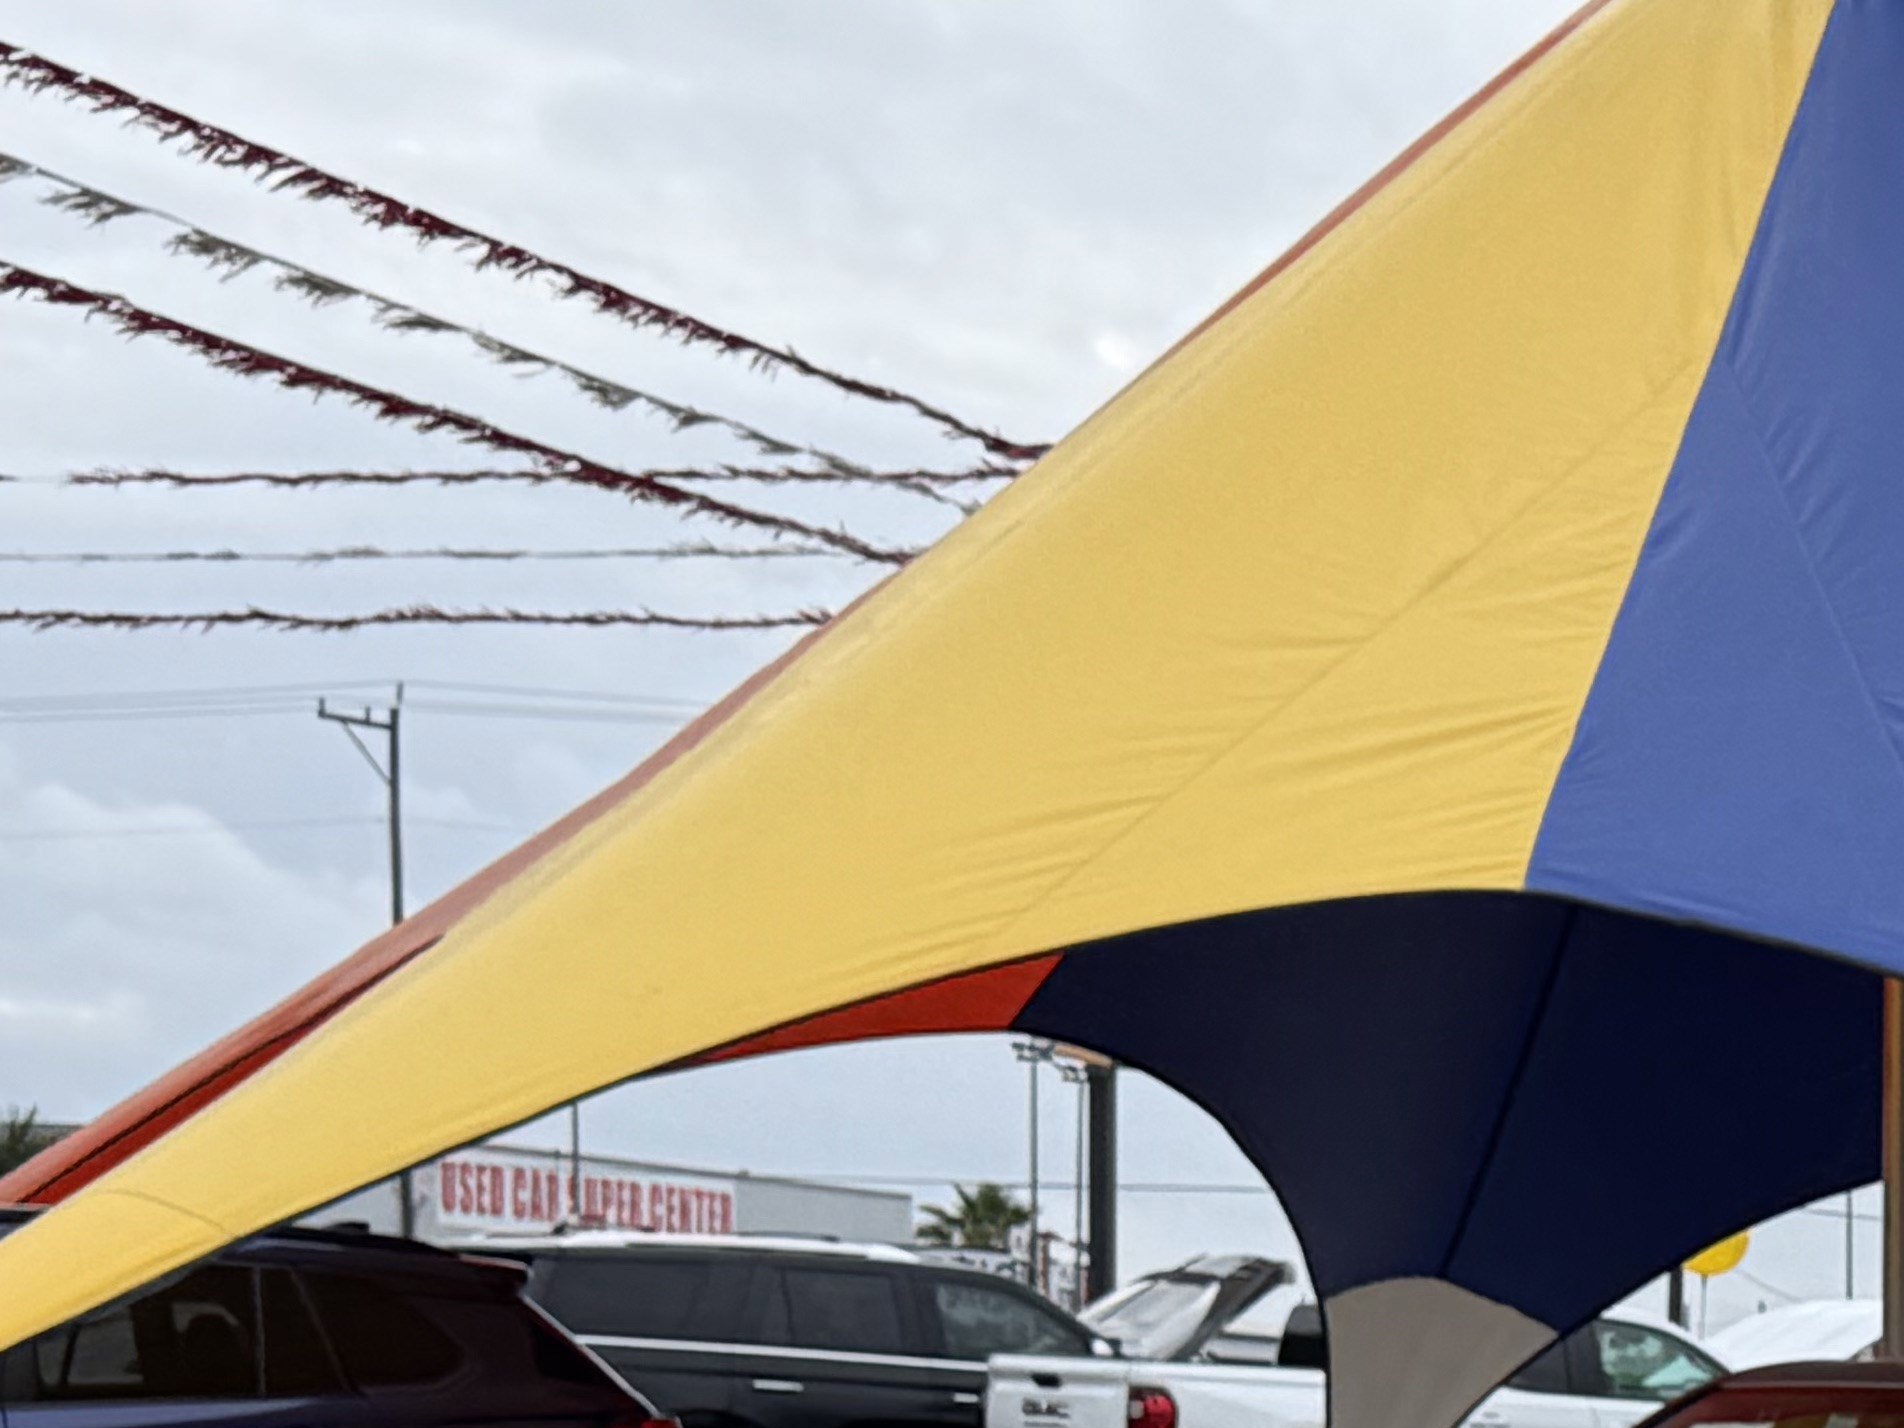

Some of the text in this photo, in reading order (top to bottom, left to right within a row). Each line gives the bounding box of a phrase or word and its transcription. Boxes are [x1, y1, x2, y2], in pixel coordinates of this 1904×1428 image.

[440, 1162, 504, 1217] USED
[513, 1166, 559, 1221] CAR
[650, 1183, 732, 1233] CENTER
